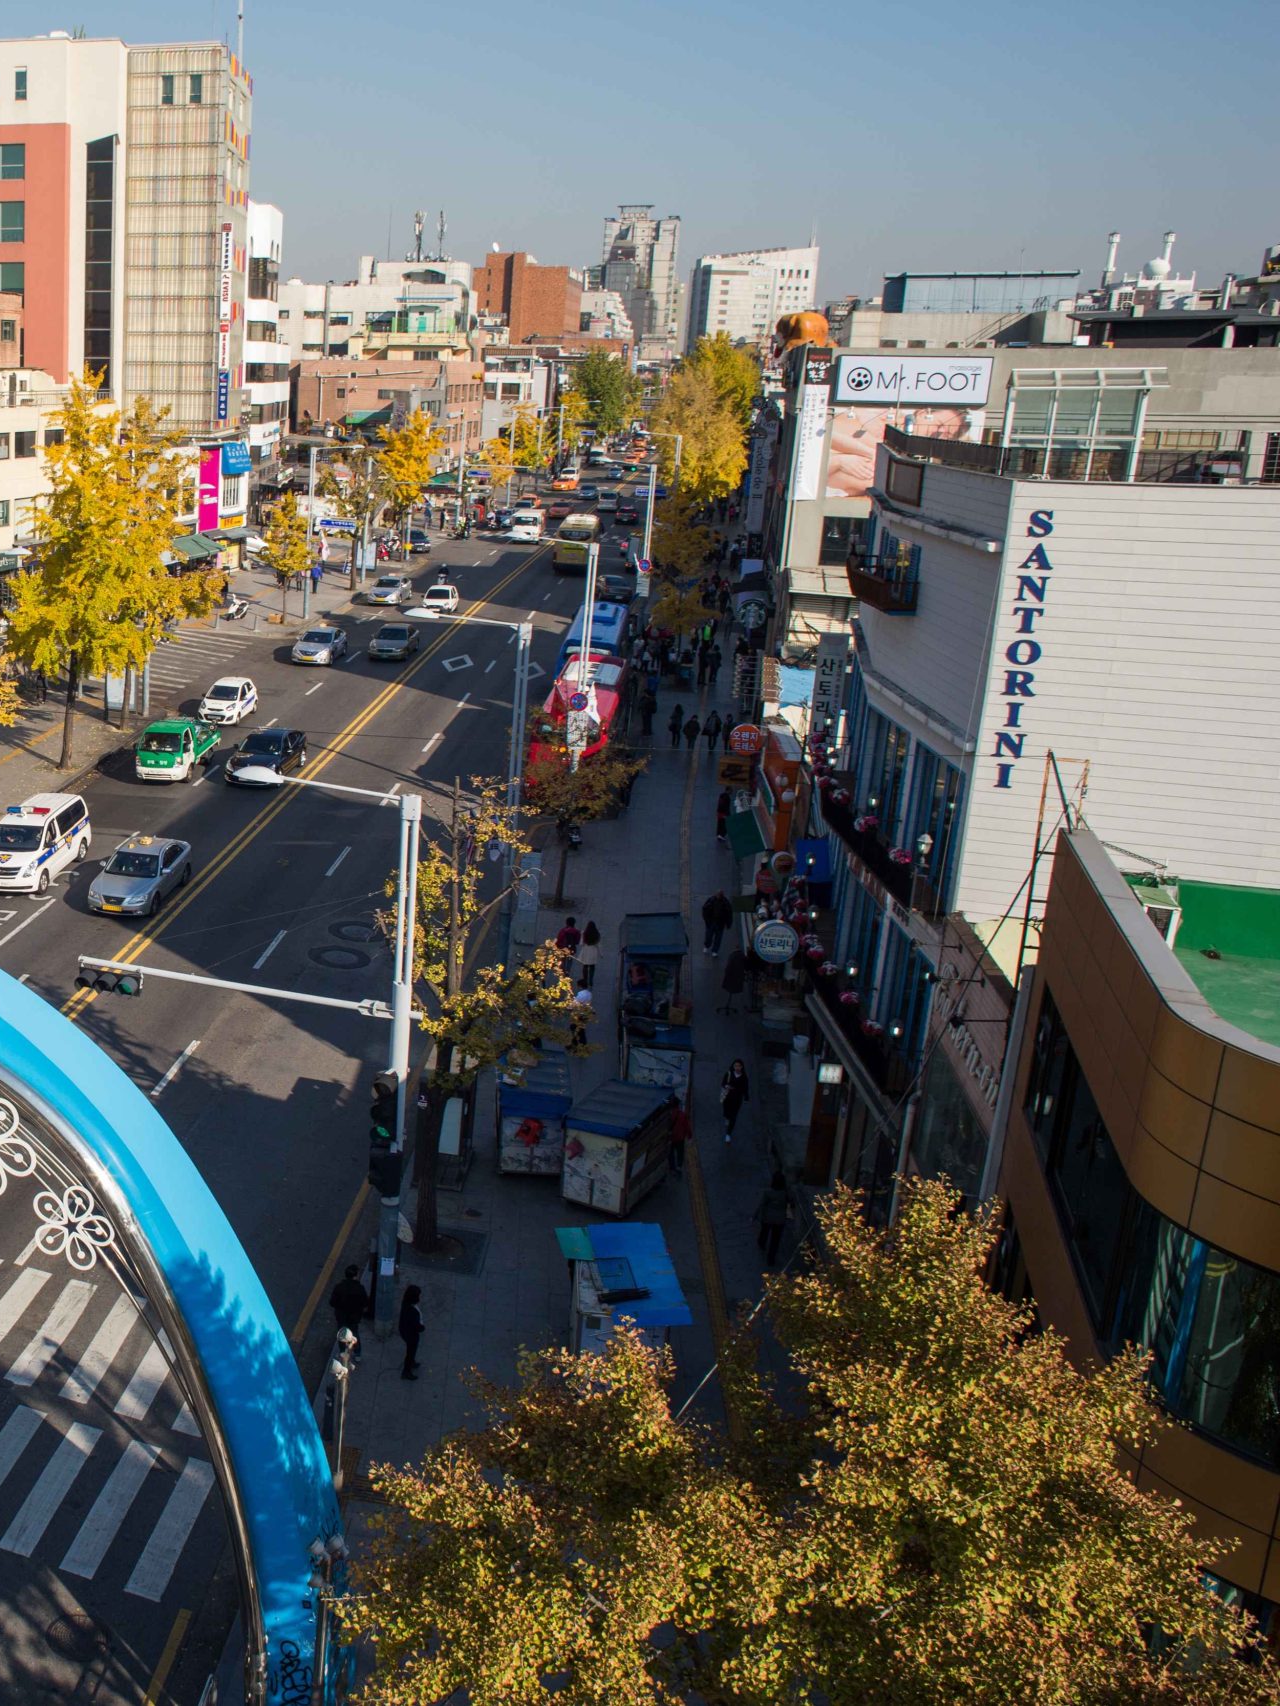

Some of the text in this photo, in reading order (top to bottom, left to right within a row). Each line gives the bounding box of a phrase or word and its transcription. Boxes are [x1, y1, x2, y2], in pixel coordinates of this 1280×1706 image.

[876, 372, 982, 391] Mr. FOOT
[990, 509, 1054, 789] SANTORINI
[732, 730, 758, 740] 오렌지
[733, 741, 756, 750] 드레스
[759, 938, 796, 950] 산토리니
